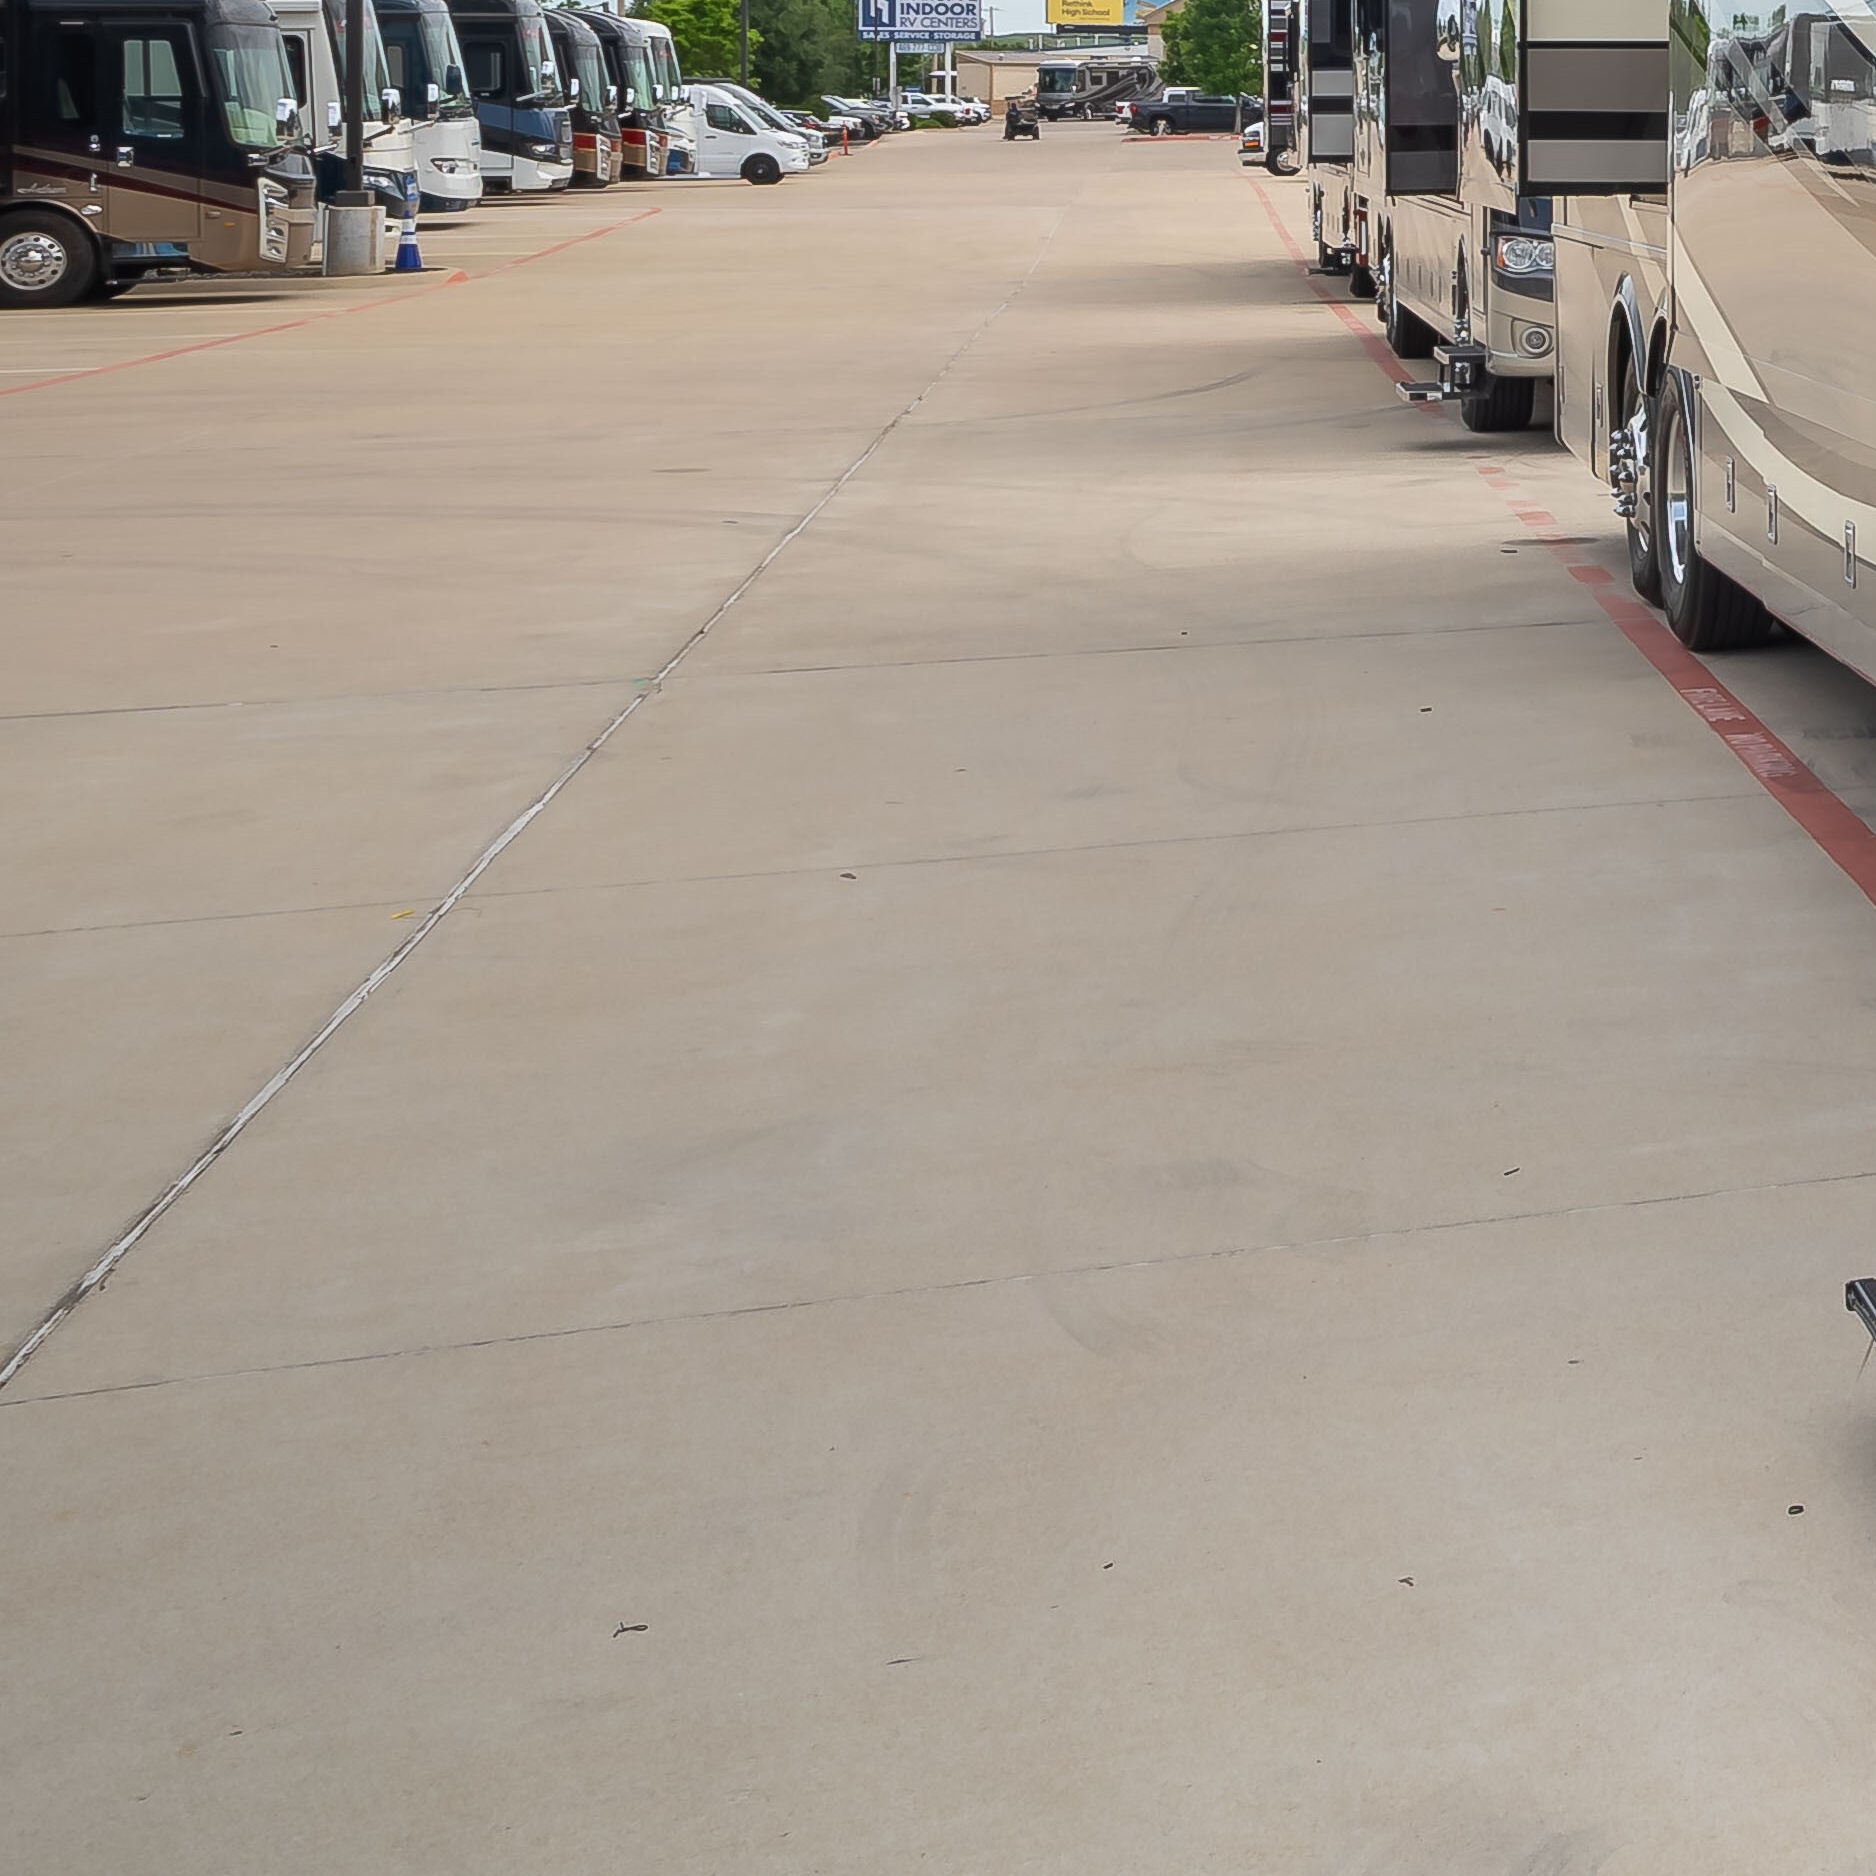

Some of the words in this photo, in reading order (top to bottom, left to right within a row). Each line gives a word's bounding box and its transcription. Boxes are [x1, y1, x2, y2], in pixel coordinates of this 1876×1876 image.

[1061, 0, 1093, 8] Rethink
[900, 3, 977, 16] INDOOR
[1061, 8, 1081, 17] High
[900, 17, 917, 28] RV
[920, 17, 978, 29] CENTERS
[894, 32, 930, 40] SERVICE
[933, 32, 976, 40] STORAGE
